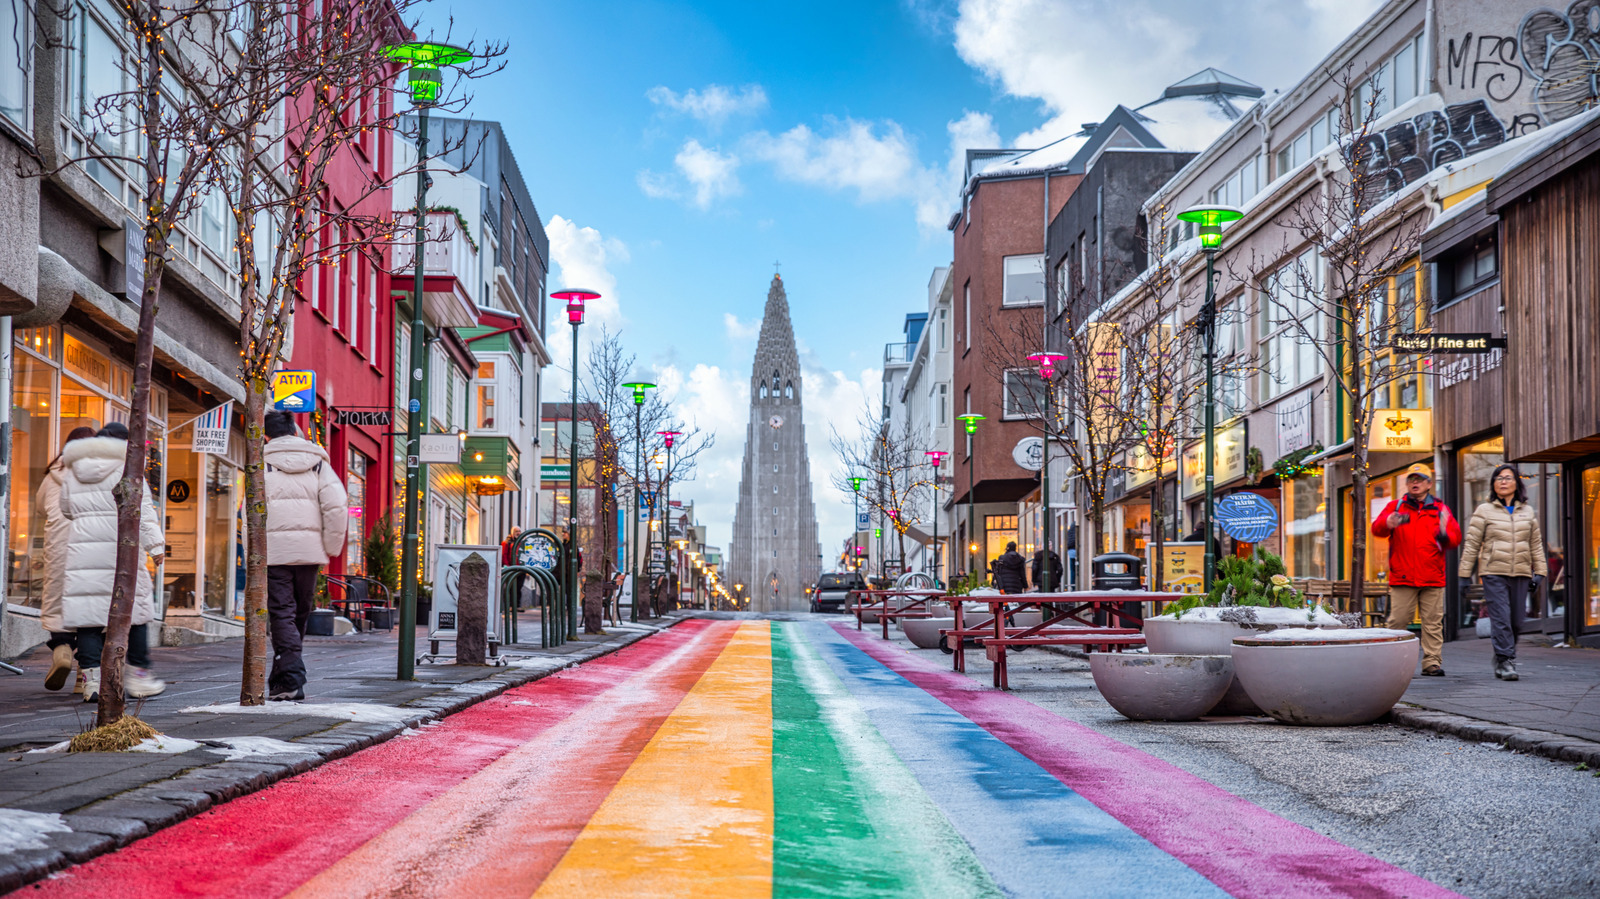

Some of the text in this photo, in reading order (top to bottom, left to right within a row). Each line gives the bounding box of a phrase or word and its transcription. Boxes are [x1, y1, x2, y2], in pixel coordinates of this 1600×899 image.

[1438, 336, 1464, 349] fine
[1466, 339, 1487, 349] art
[1440, 353, 1470, 390] iurie
[279, 374, 308, 385] ATM
[338, 410, 391, 427] MOKKA
[197, 430, 226, 440] TAX FREE
[196, 438, 226, 448] SHOPPING
[421, 443, 455, 452] Kaolin
